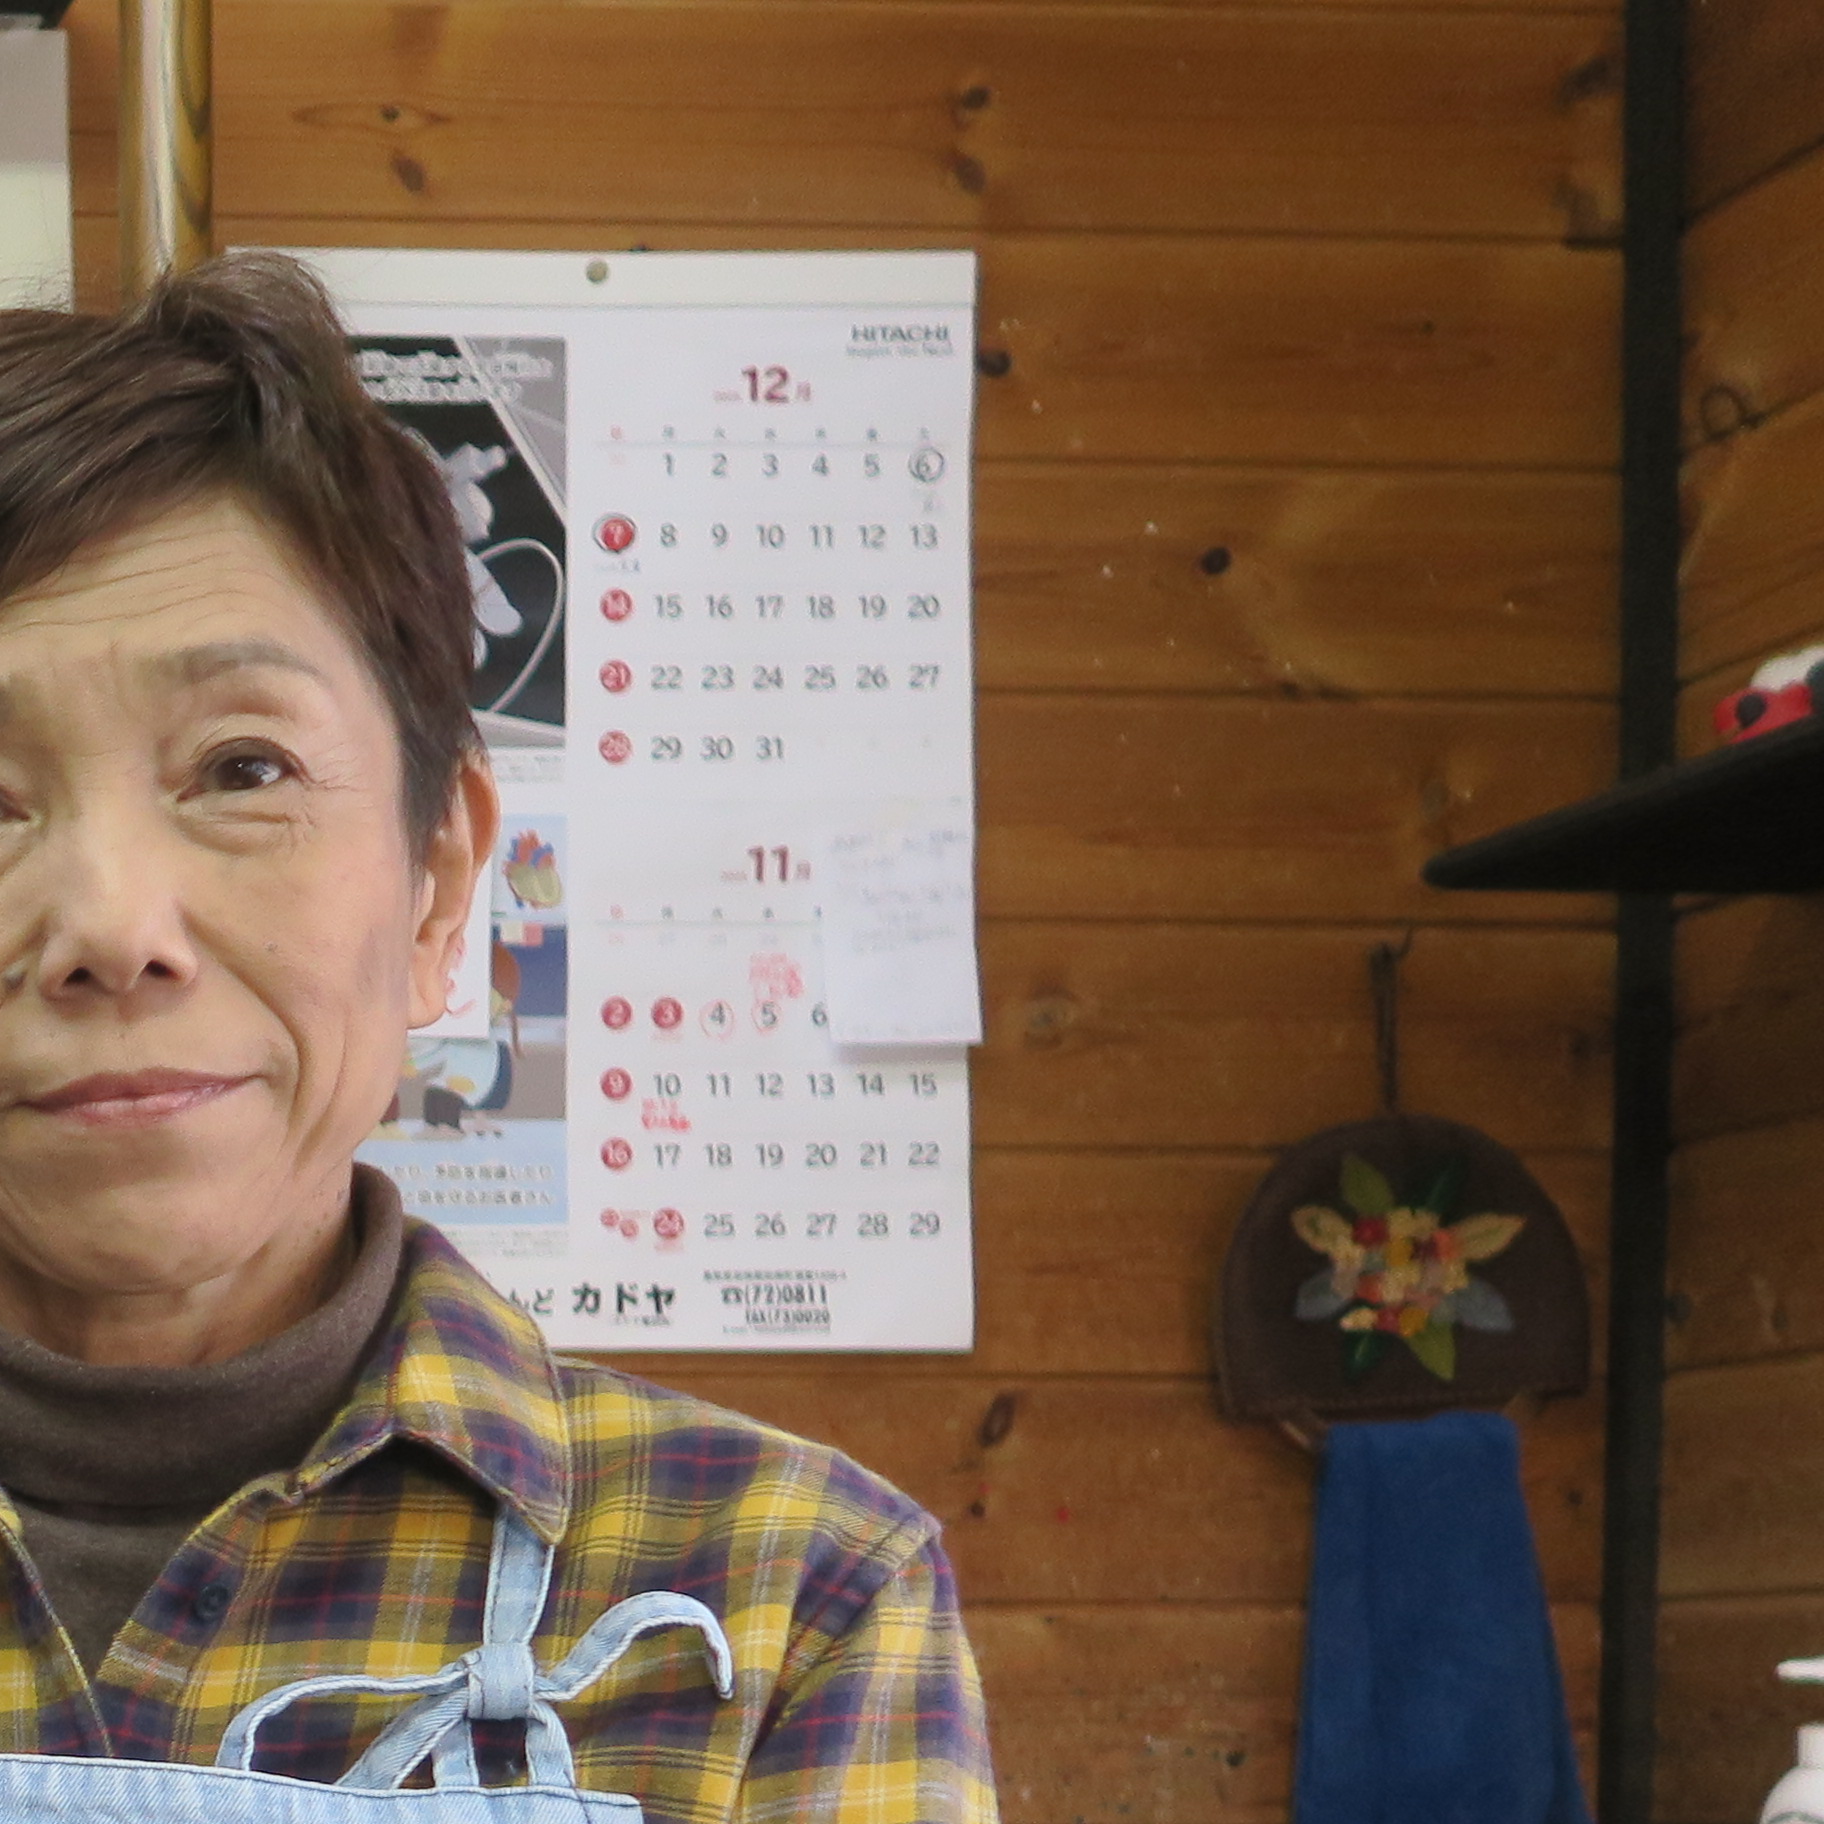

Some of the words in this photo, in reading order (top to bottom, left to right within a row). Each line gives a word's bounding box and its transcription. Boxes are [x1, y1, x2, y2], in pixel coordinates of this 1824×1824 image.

[851, 324, 949, 342] HITACHI
[664, 453, 675, 477] 1
[712, 453, 729, 479] 2
[764, 454, 780, 479] 3
[812, 454, 831, 478] 4
[865, 454, 882, 479] 5
[660, 524, 678, 549] 8
[712, 524, 730, 549] 9
[758, 525, 787, 551] 10
[811, 525, 835, 549] 11
[860, 526, 888, 551] 12
[911, 525, 939, 551] 13
[656, 595, 684, 620] 15
[706, 595, 735, 621] 16
[756, 596, 785, 619] 17
[809, 596, 837, 621] 18
[859, 596, 889, 620] 19
[908, 595, 942, 620] 20
[651, 666, 684, 692] 22
[702, 666, 736, 692] 23
[753, 666, 785, 692] 24
[805, 666, 838, 692] 25
[857, 666, 891, 691] 26
[909, 665, 941, 691] 27
[651, 737, 684, 762] 29
[702, 737, 736, 762] 30
[757, 737, 785, 762] 31
[710, 1002, 725, 1025] 4
[762, 1002, 778, 1027] 5
[812, 1002, 828, 1027] 6
[655, 1074, 682, 1098] 10
[708, 1073, 732, 1098] 11
[759, 1074, 785, 1098] 12
[807, 1073, 836, 1098] 13
[858, 1074, 886, 1097] 14
[908, 1074, 937, 1097] 15
[655, 1144, 682, 1169] 17
[706, 1144, 734, 1169] 18
[756, 1144, 786, 1168] 19
[806, 1143, 839, 1169] 20
[860, 1143, 888, 1168] 21
[909, 1143, 941, 1168] 22
[704, 1214, 736, 1239] 25
[756, 1214, 788, 1239] 26
[807, 1214, 838, 1238] 27
[858, 1213, 890, 1239] 28
[910, 1213, 942, 1238] 29
[571, 1282, 676, 1316] カドヤ
